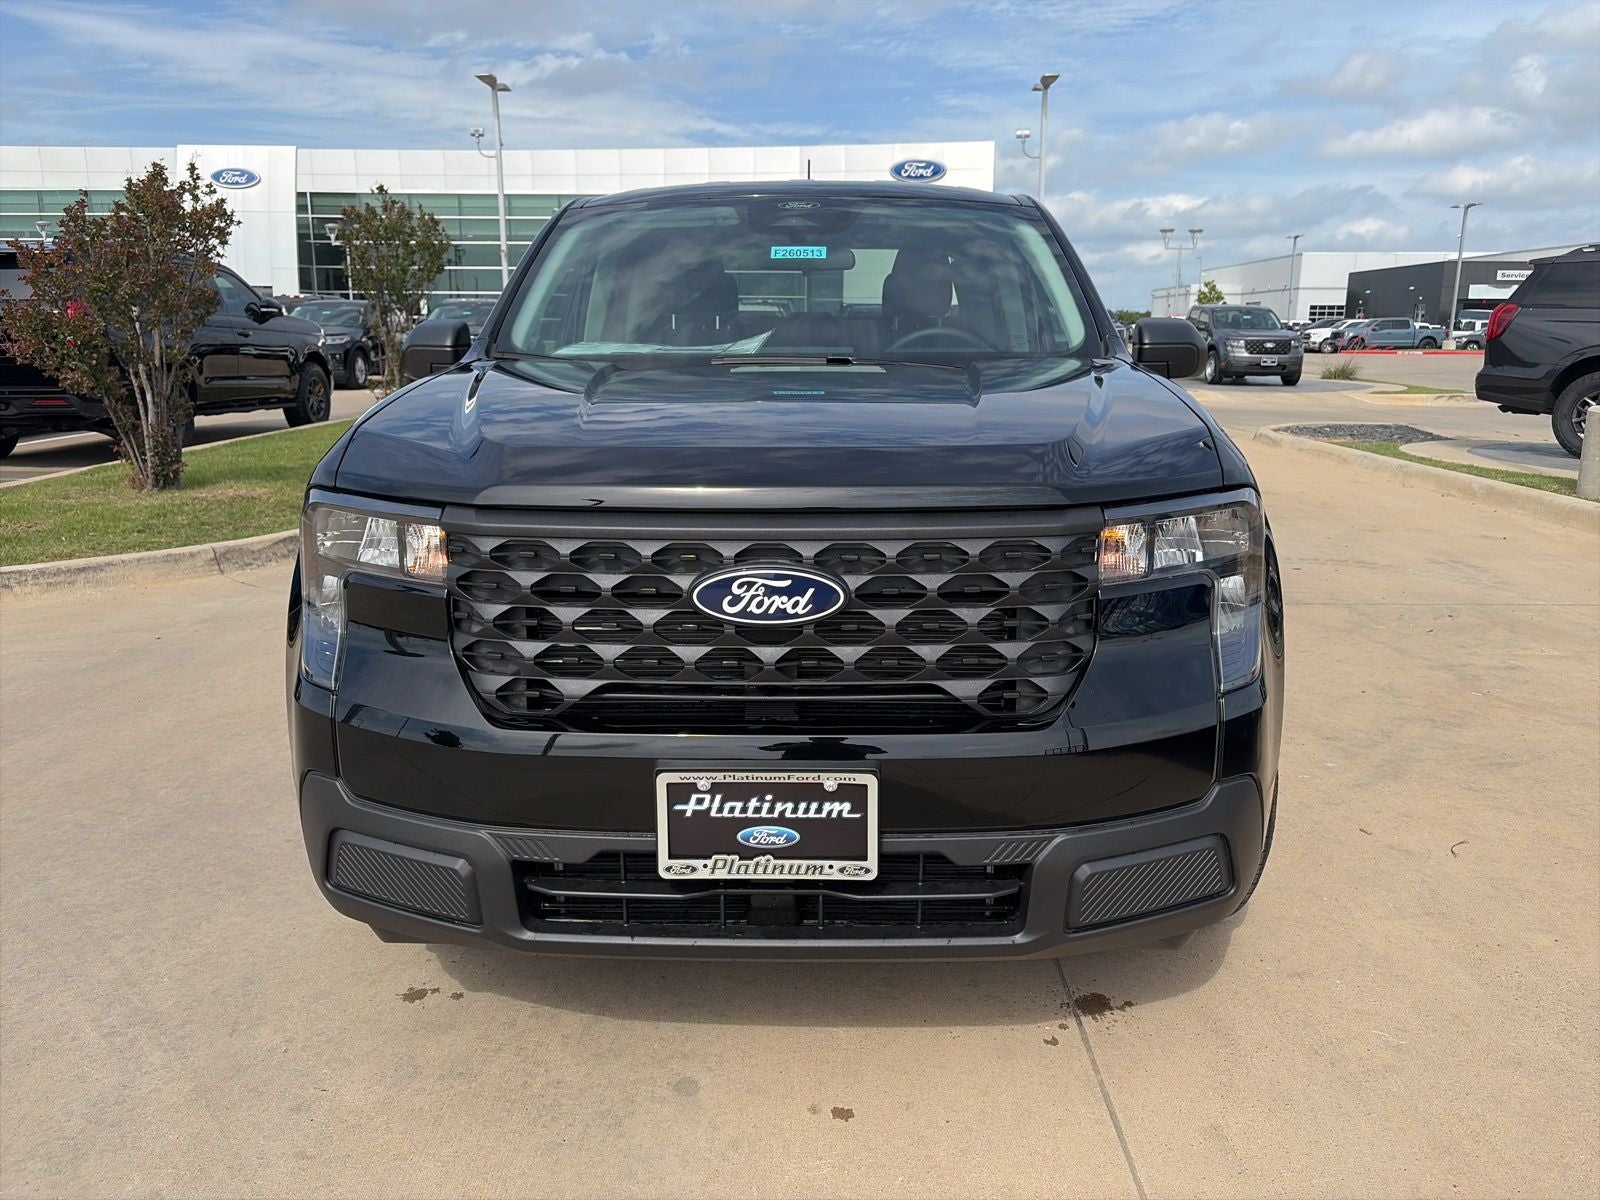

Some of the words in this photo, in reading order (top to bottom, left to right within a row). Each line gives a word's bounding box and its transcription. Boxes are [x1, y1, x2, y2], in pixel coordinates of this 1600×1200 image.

[219, 170, 248, 183] Ford
[901, 162, 934, 177] Ford
[774, 249, 823, 257] F260513
[722, 577, 815, 615] Ford
[679, 774, 857, 782] www.PlatinumFord.com
[672, 794, 864, 818] Platinum
[749, 830, 787, 844] Ford
[669, 863, 692, 874] Ford
[709, 858, 834, 876] Platinum
[843, 865, 866, 875] Ford
